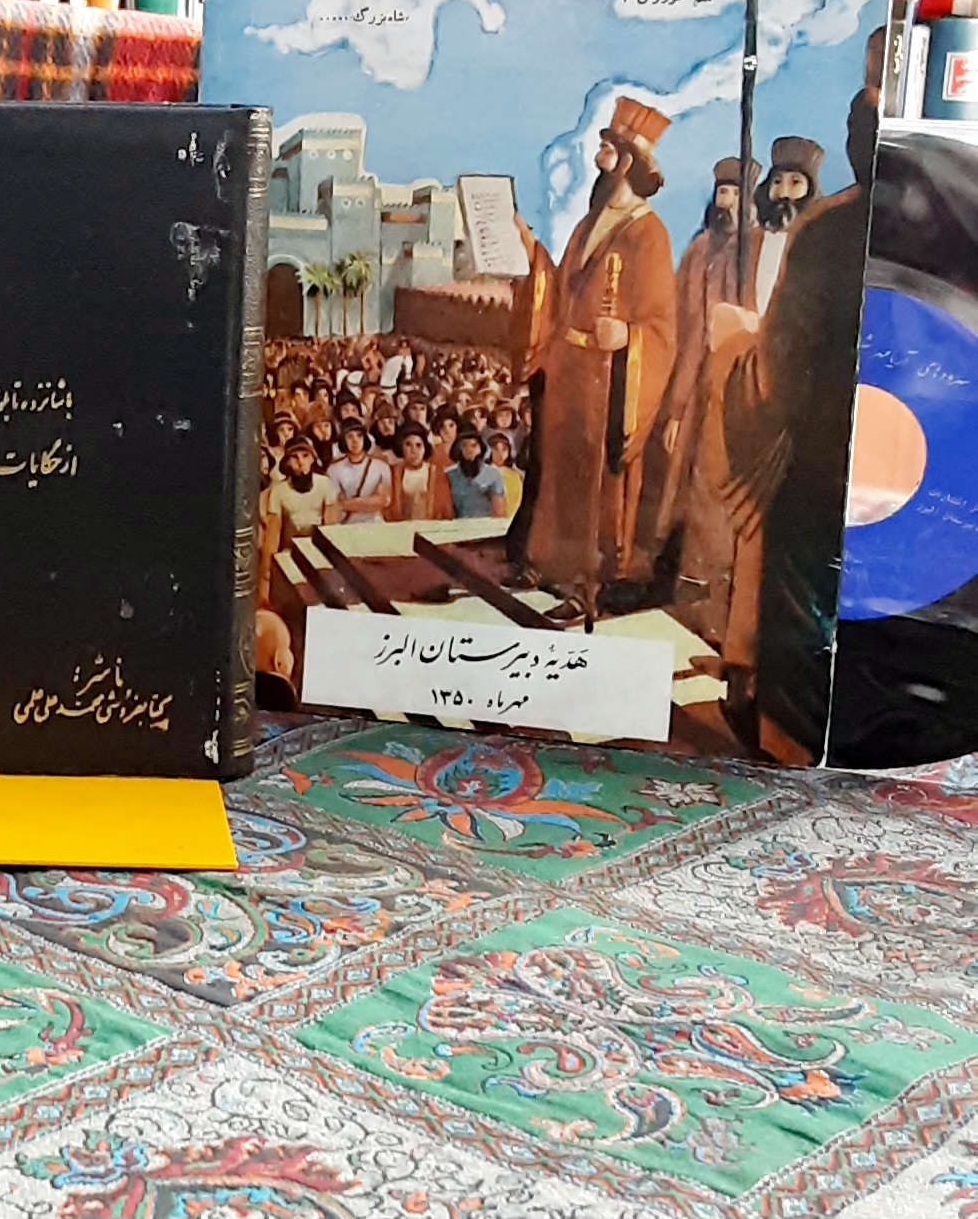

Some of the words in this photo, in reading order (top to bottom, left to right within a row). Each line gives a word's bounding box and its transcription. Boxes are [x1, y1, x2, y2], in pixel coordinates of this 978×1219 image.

[58, 443, 78, 477] از
[373, 634, 418, 667] البرز
[419, 635, 540, 680] دبیرستان
[430, 688, 474, 707] ۱۳۵۰
